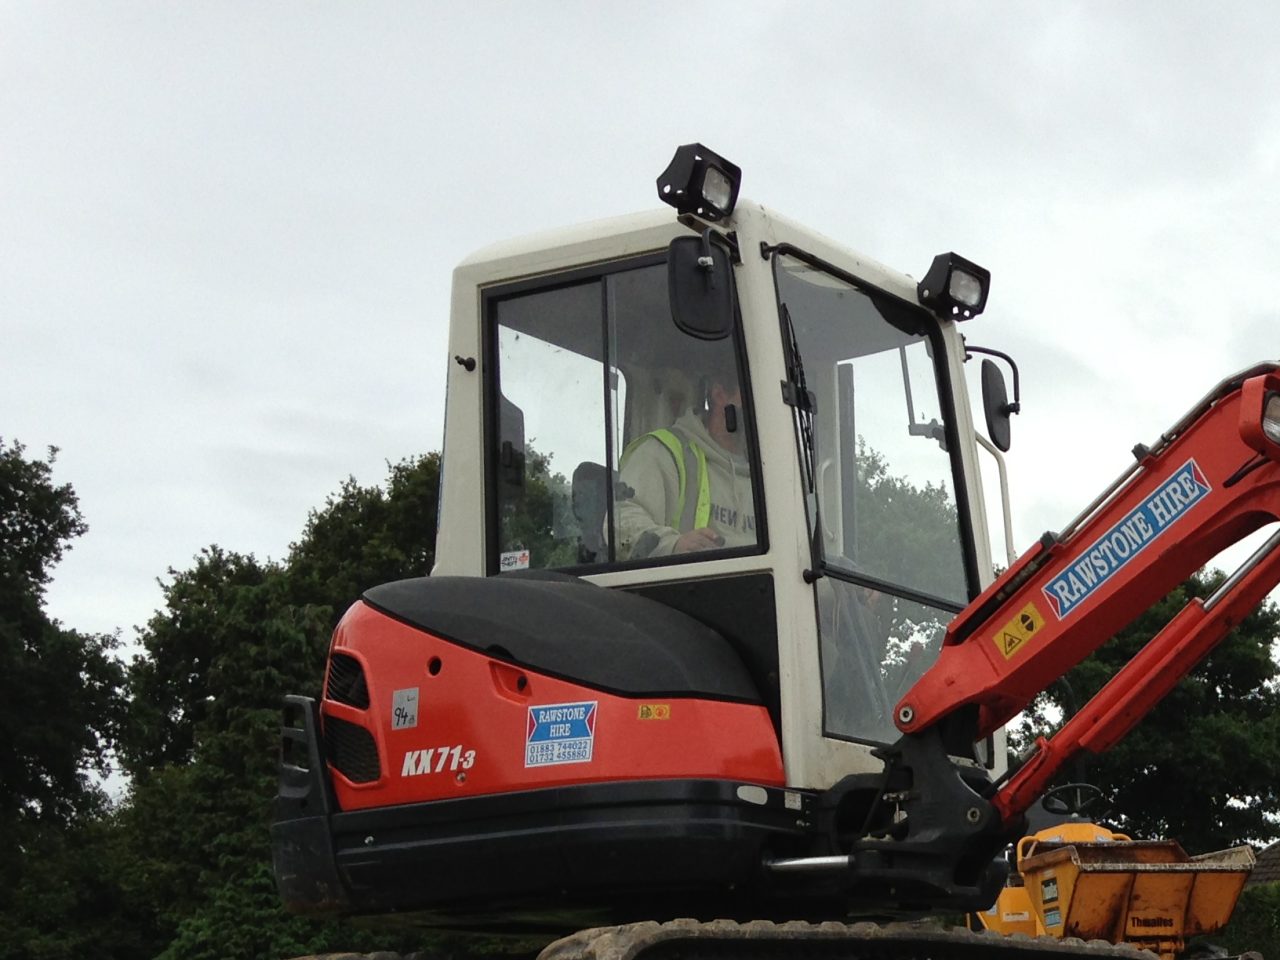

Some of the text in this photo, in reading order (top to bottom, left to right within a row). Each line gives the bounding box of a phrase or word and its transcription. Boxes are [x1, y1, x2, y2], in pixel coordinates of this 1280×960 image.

[1053, 471, 1200, 609] RAWSTONE HIRE
[395, 706, 408, 726] 94
[539, 707, 586, 724] RAWSTONE
[549, 723, 571, 738] HIRE
[529, 752, 554, 764] 01732
